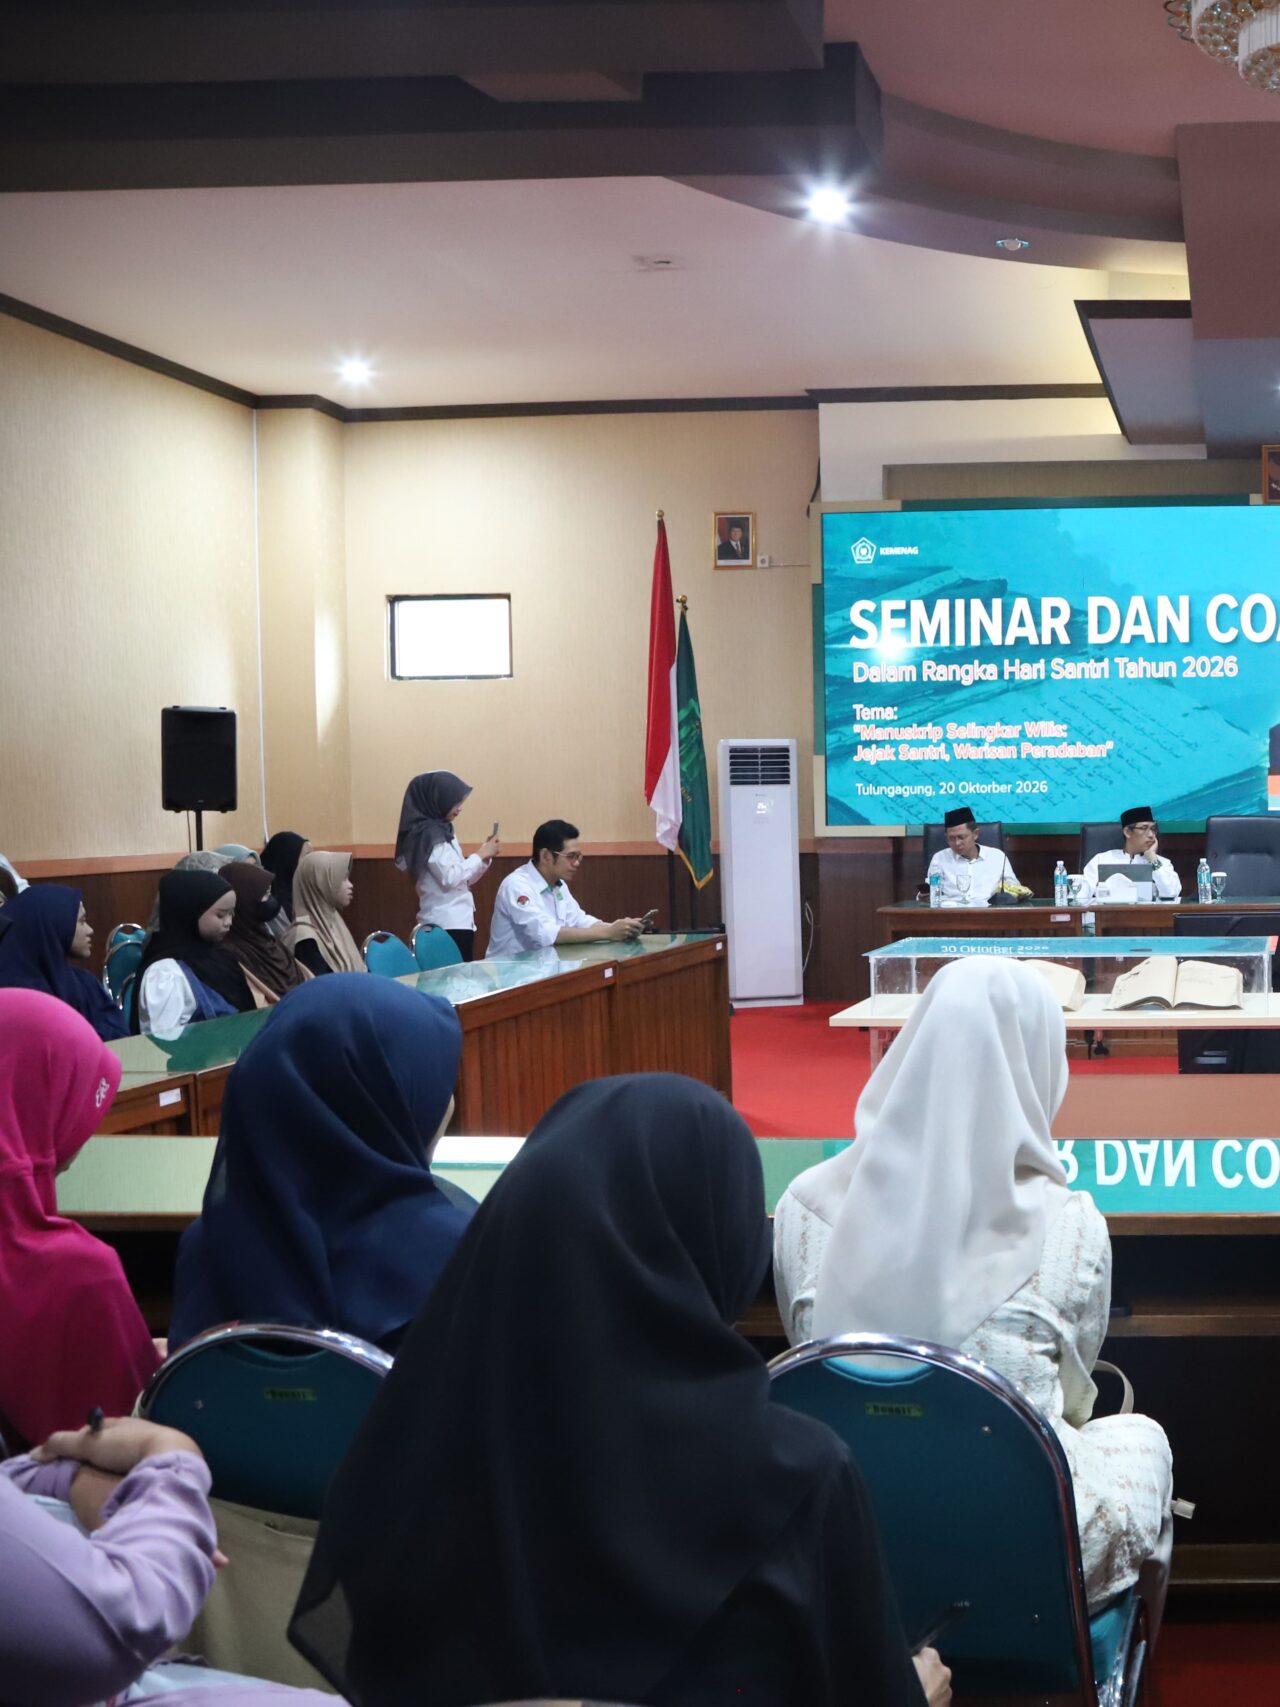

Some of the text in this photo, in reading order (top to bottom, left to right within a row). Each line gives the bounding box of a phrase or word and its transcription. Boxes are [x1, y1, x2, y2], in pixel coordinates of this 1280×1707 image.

[880, 546, 919, 556] KEMENAG
[849, 597, 1072, 649] SEMINAR
[1087, 595, 1191, 645] DAN
[852, 655, 1239, 686] Dalam Rangka Hari Santri Tahun 2026
[853, 704, 898, 721] Tema:
[853, 720, 1068, 742] "Manuskrip Selingkar Willis:
[853, 741, 1114, 765] Jejak Santri, Warisan Peradaban"
[855, 780, 1048, 798] Tulungagung, 20 Oktorber 2026
